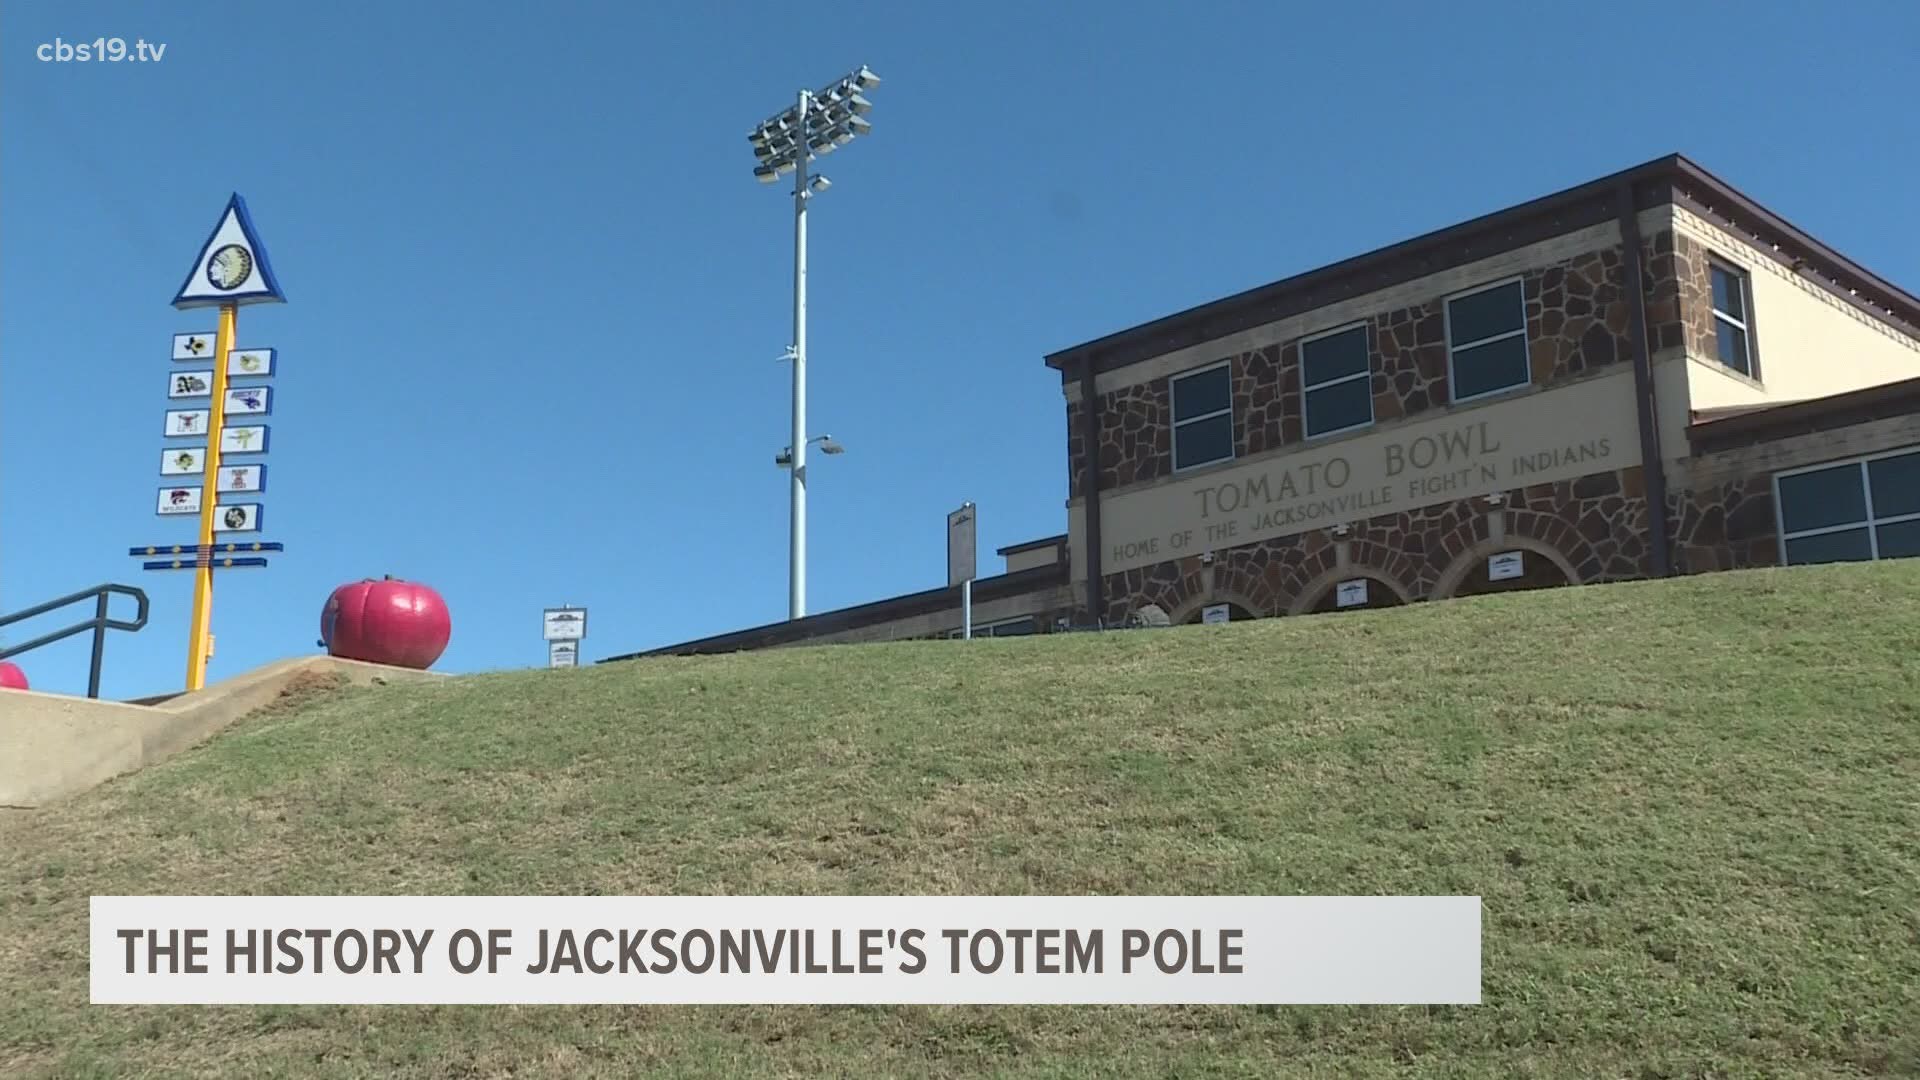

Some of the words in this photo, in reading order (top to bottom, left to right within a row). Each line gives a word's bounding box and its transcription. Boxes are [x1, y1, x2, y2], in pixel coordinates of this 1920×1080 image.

[1113, 538, 1160, 561] HOME
[1170, 530, 1193, 548] OF
[1205, 521, 1239, 542] THE
[1253, 486, 1393, 530] JACKSONVILLE
[1409, 463, 1498, 498] FIGHT'N
[1512, 439, 1611, 475] INDIANS
[1193, 458, 1351, 518] TOMATO
[1384, 422, 1500, 477] BOWL
